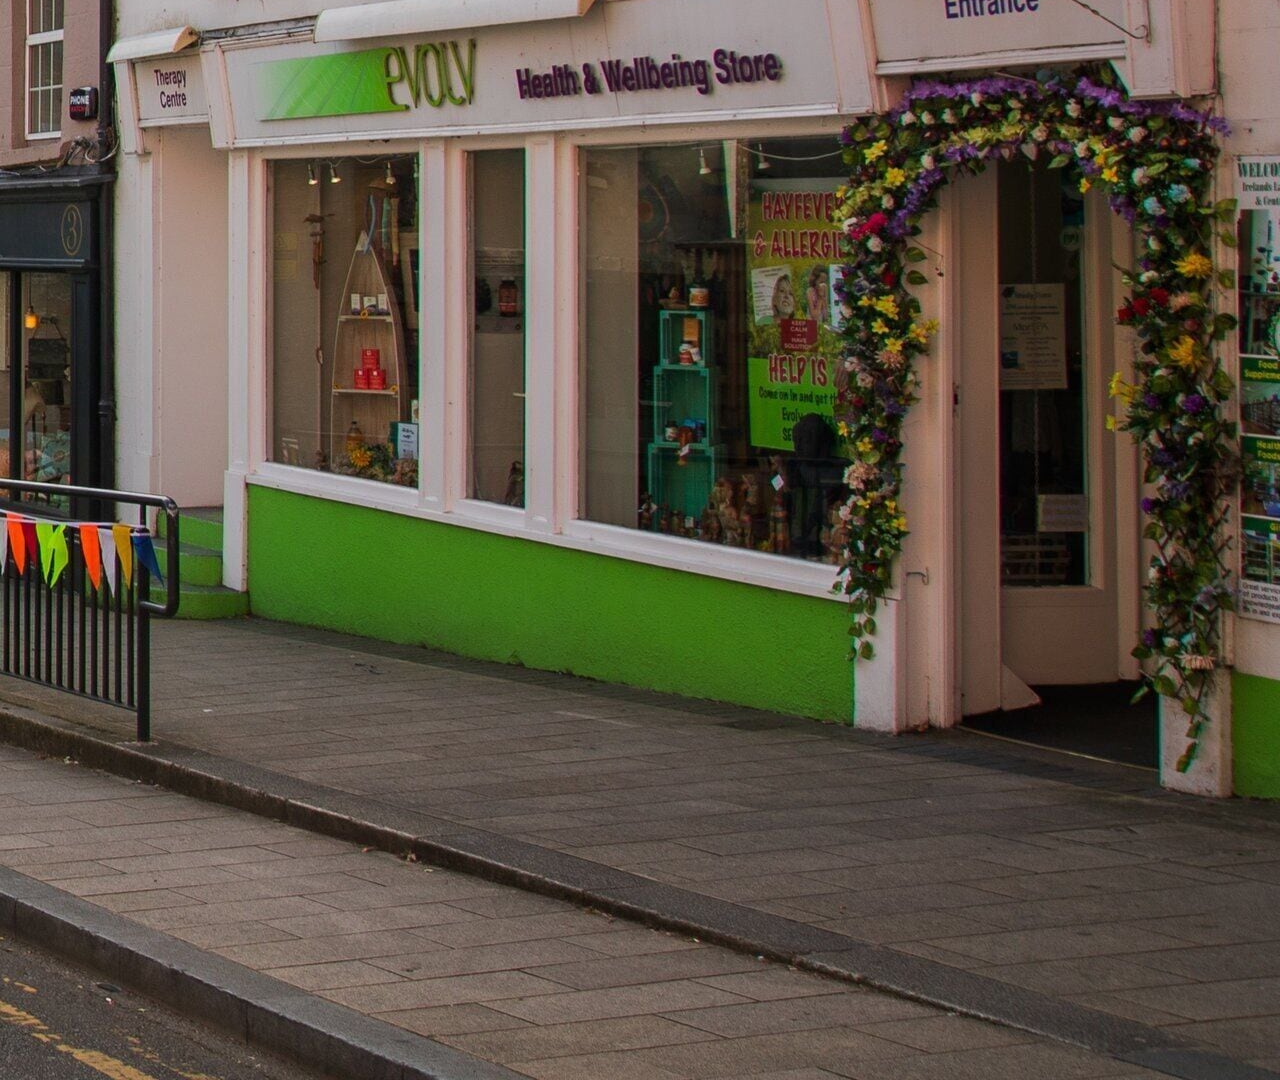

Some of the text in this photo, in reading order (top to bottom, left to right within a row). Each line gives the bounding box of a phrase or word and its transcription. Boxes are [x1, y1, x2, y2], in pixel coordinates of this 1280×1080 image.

[154, 69, 186, 88] Therapy
[516, 49, 782, 99] Health & Wellbeing Store
[160, 91, 187, 108] Centre
[1237, 162, 1280, 178] WELCO
[754, 229, 845, 259] & ALLERGIE
[768, 353, 807, 385] HELP
[811, 356, 828, 388] IS
[1258, 360, 1278, 370] Food
[759, 386, 777, 399] Come
[779, 391, 789, 400] on
[800, 390, 813, 402] and
[815, 393, 828, 406] get
